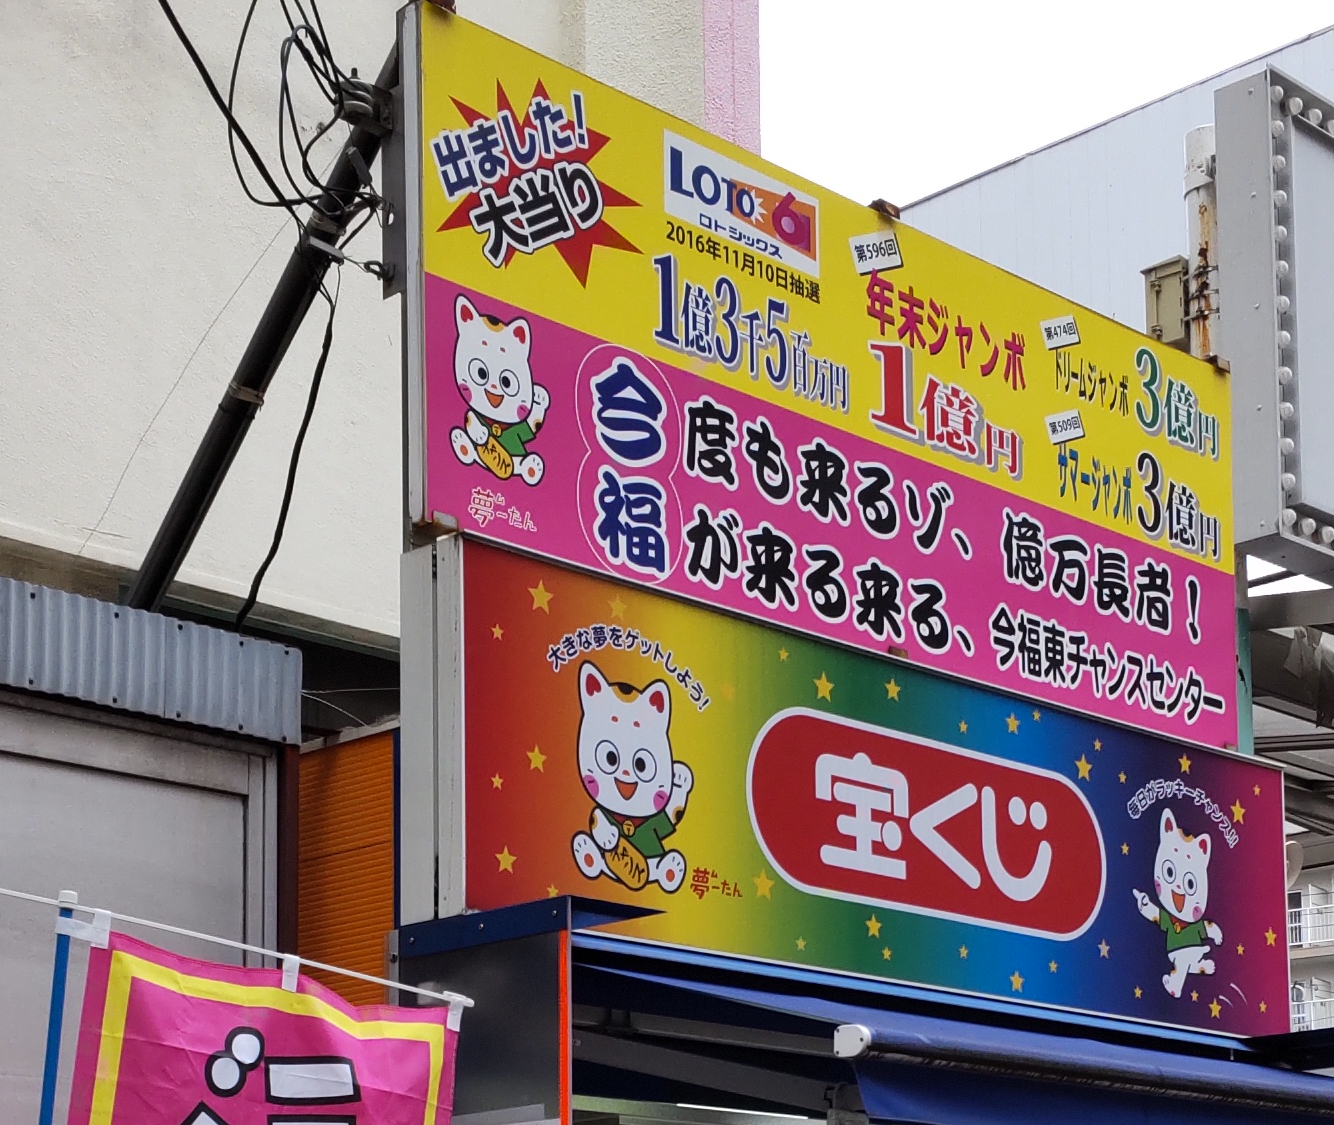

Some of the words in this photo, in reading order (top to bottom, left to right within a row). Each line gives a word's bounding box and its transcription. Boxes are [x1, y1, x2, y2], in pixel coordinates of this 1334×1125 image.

[431, 92, 588, 200] 出ました!
[670, 146, 755, 218] LOTO
[471, 162, 603, 264] 大当り
[699, 212, 784, 259] ロトシックス
[854, 239, 898, 263] 第596回
[666, 220, 821, 304] 2016年11月10日抽選
[653, 254, 849, 412] 1億3千5百万円
[866, 268, 1027, 391] 年末ジャンボ
[1044, 321, 1077, 341] 第474回
[869, 341, 1021, 476] 1億円
[1049, 415, 1081, 435] 第509回
[1055, 348, 1129, 416] ドリームジャンボ
[1134, 347, 1219, 458] 3億円
[1058, 444, 1133, 525] サマージャンボ
[1136, 452, 1221, 558] 3億円
[548, 623, 711, 713] 大きな夢をゲットしよう!
[988, 603, 1226, 726] 今福東チャンスセンター
[813, 752, 1053, 901] 宝くじ
